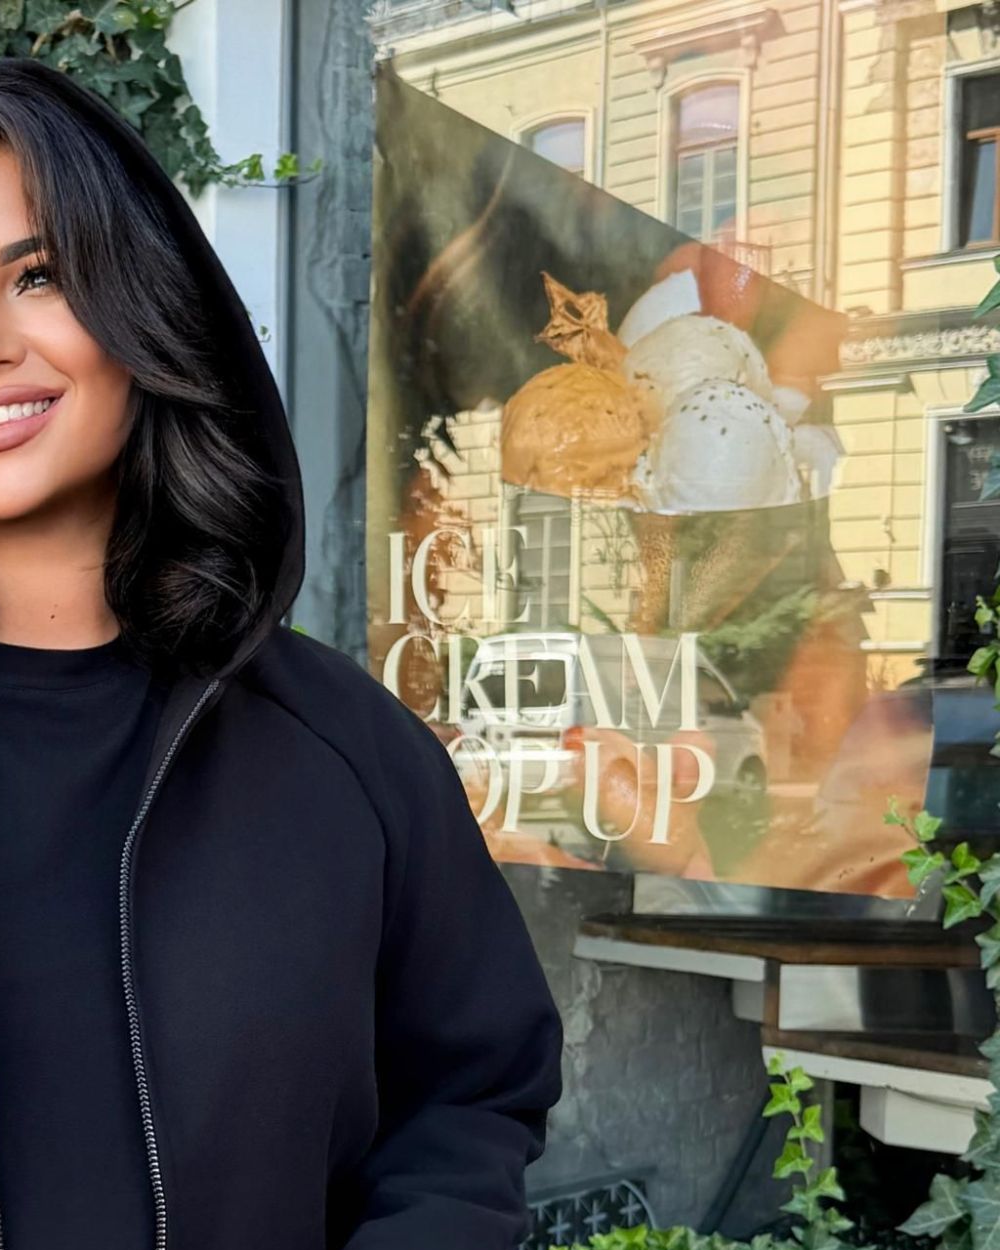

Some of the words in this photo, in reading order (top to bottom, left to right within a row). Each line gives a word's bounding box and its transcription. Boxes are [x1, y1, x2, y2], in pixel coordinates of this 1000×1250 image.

[387, 525, 532, 625] ICE
[383, 632, 701, 731] CREAM
[446, 735, 560, 833] OP
[582, 741, 716, 845] UP
